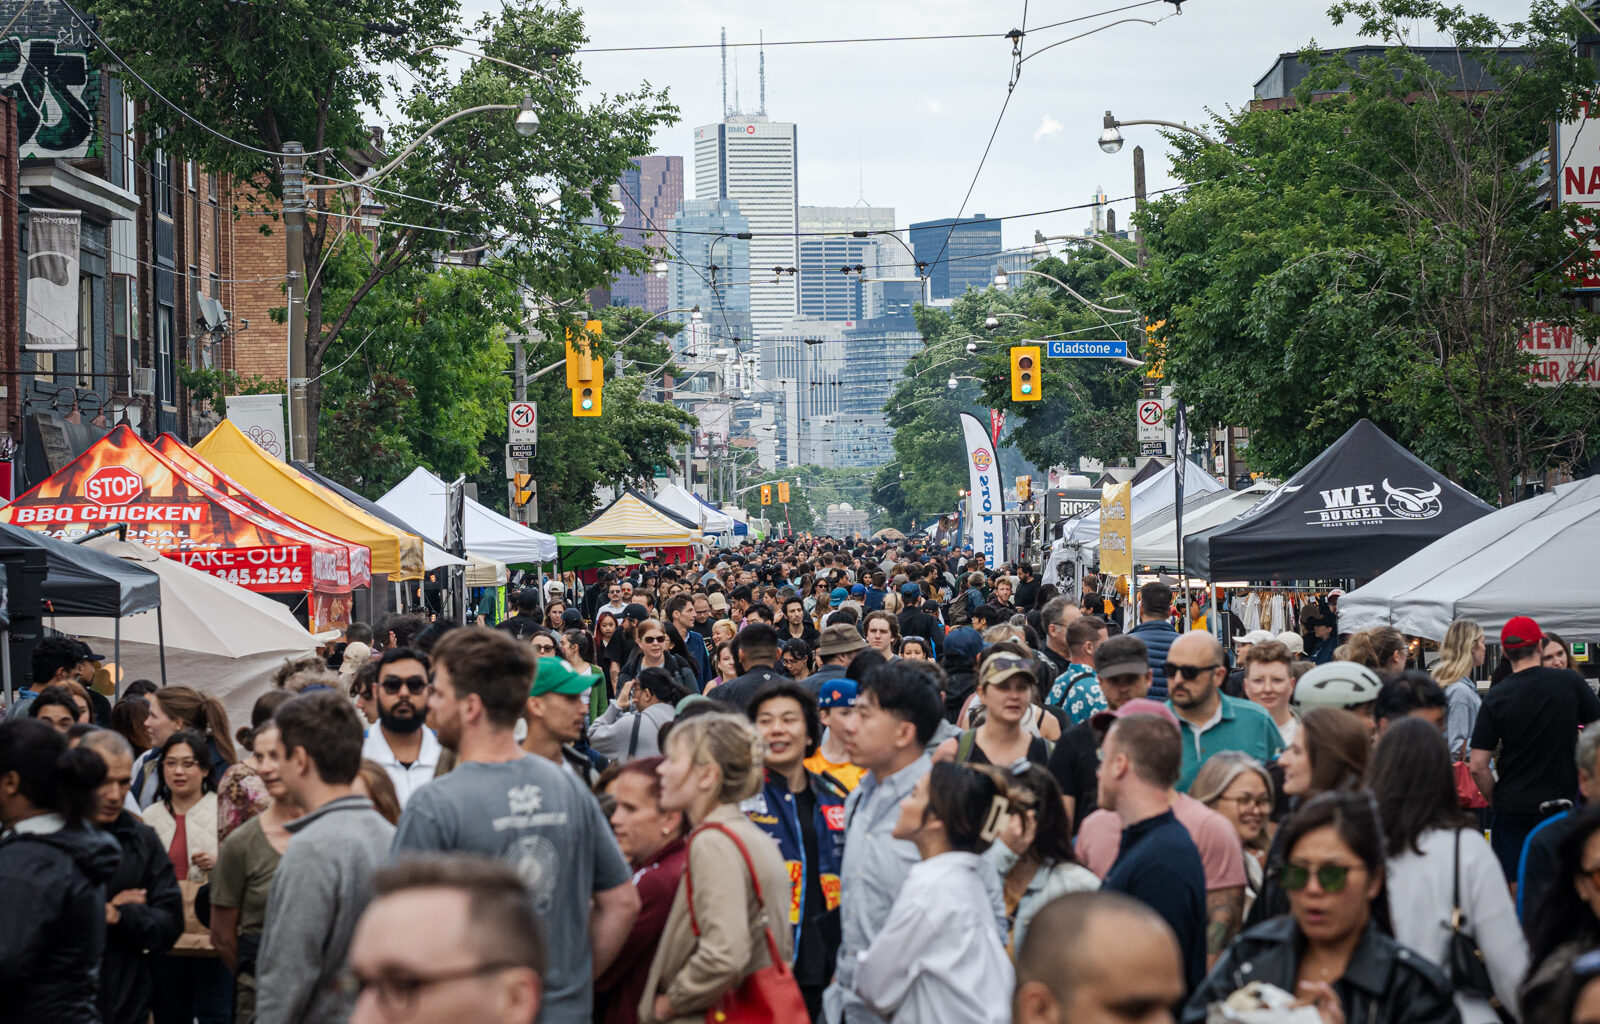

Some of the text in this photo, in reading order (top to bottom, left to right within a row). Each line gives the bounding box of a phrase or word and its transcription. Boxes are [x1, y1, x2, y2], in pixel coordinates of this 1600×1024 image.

[1518, 323, 1573, 349] NEW
[1053, 342, 1110, 354] Gladstone
[90, 477, 138, 498] STOP
[1319, 485, 1376, 508] WE
[17, 506, 201, 522] BBQ CHICKEN
[1320, 507, 1382, 521] BURGER
